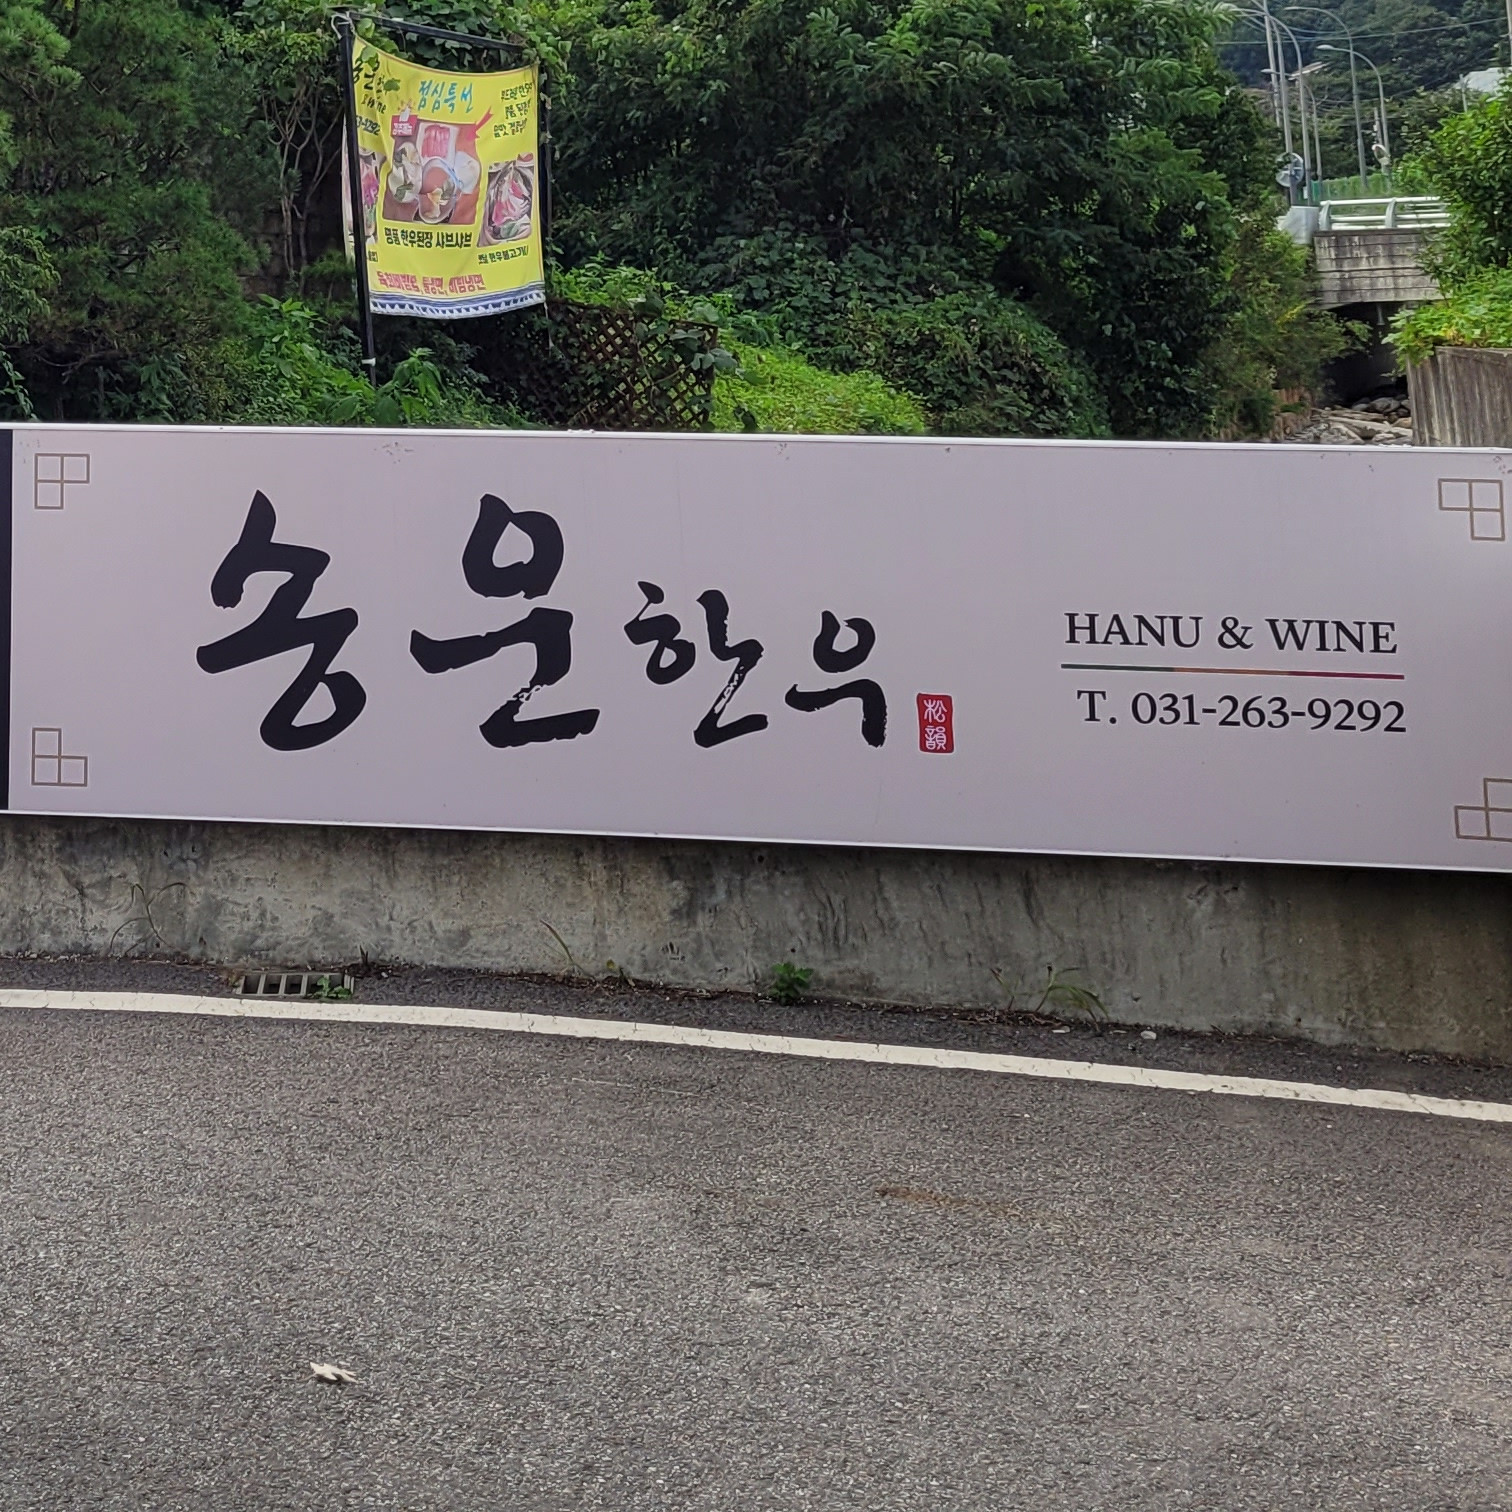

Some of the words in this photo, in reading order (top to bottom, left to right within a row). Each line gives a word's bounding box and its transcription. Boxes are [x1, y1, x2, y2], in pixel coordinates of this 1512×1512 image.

[418, 80, 473, 114] 점심특선
[435, 231, 473, 249] 샤브샤브
[196, 489, 888, 753] 송운한우
[1064, 612, 1203, 648] HANU
[1217, 616, 1254, 650] &
[1264, 618, 1398, 654] WINE
[1076, 689, 1117, 725] T.
[1131, 692, 1407, 733] 031-263-9292
